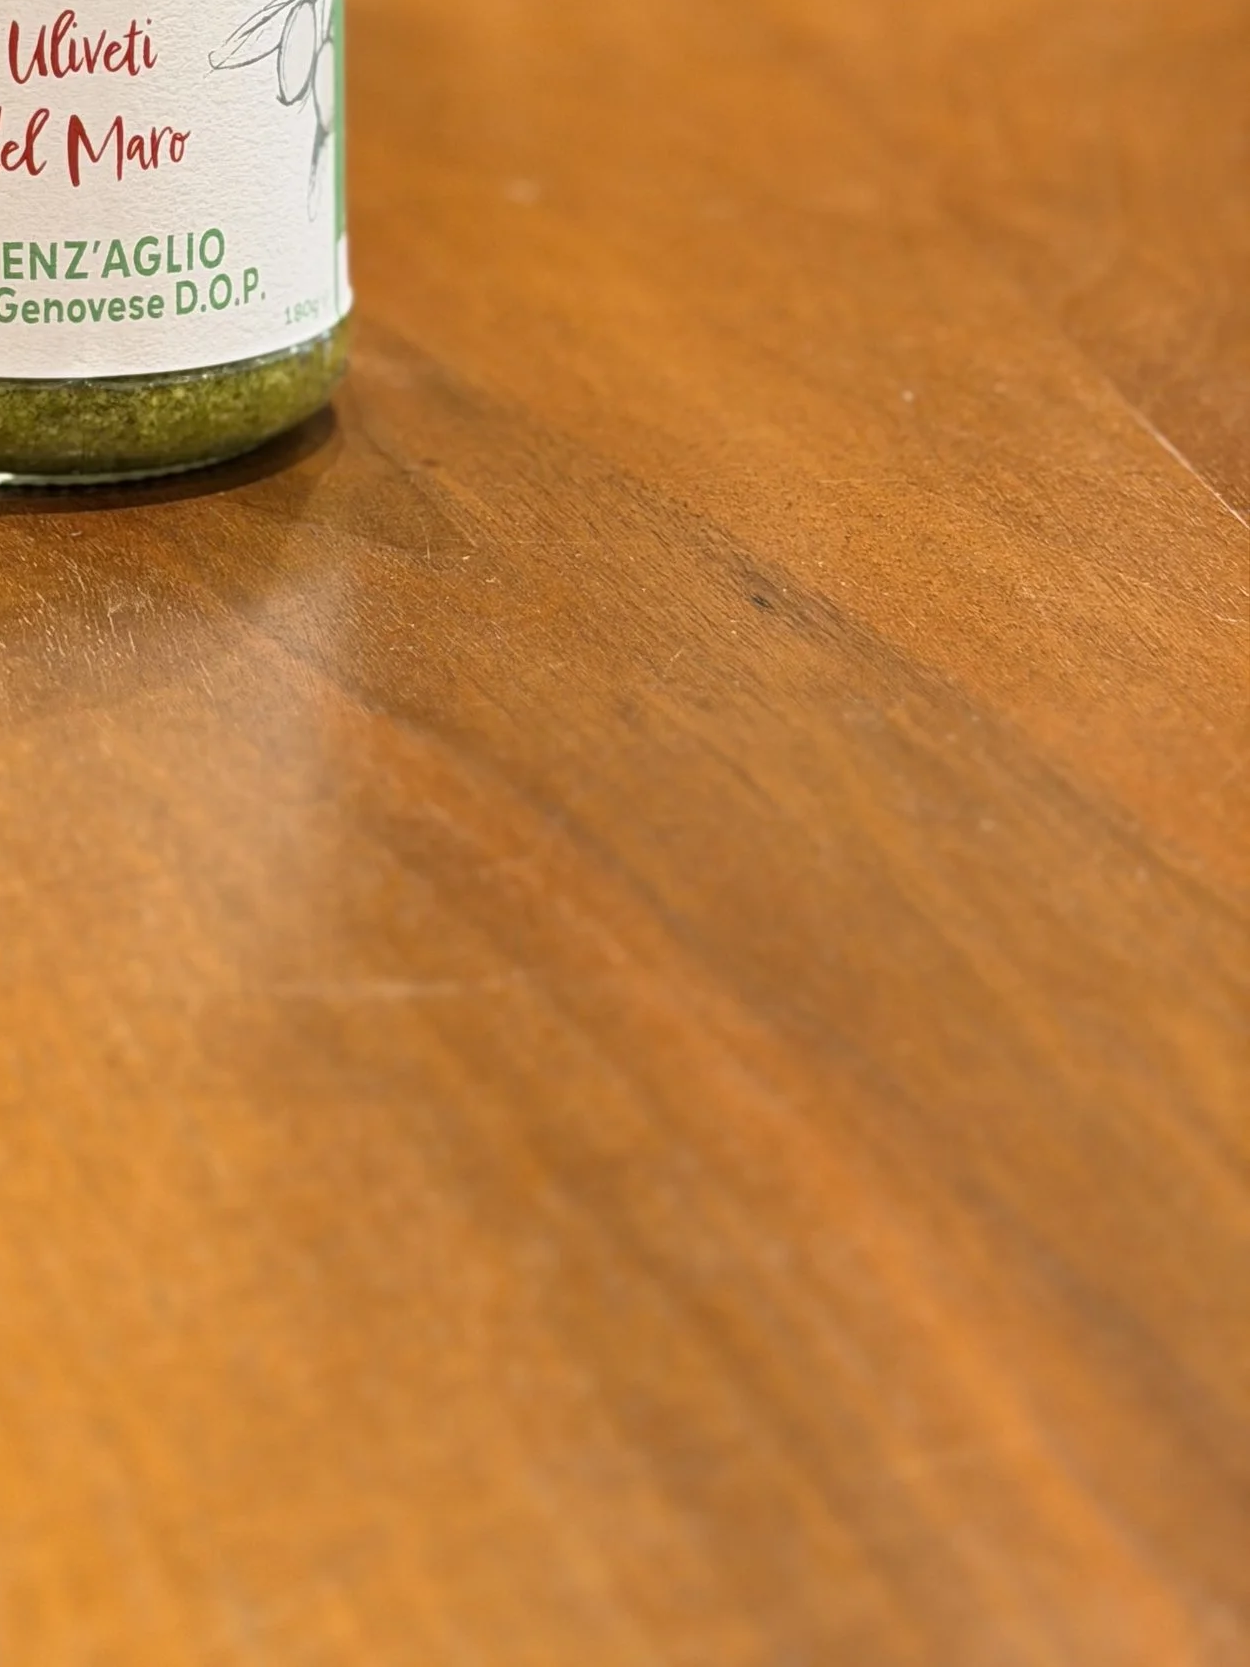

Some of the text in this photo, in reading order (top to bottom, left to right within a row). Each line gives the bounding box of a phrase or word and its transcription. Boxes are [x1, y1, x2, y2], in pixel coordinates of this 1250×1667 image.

[8, 9, 158, 84] Uliveti
[67, 114, 191, 187] Maro
[175, 266, 267, 316] D.O.P.
